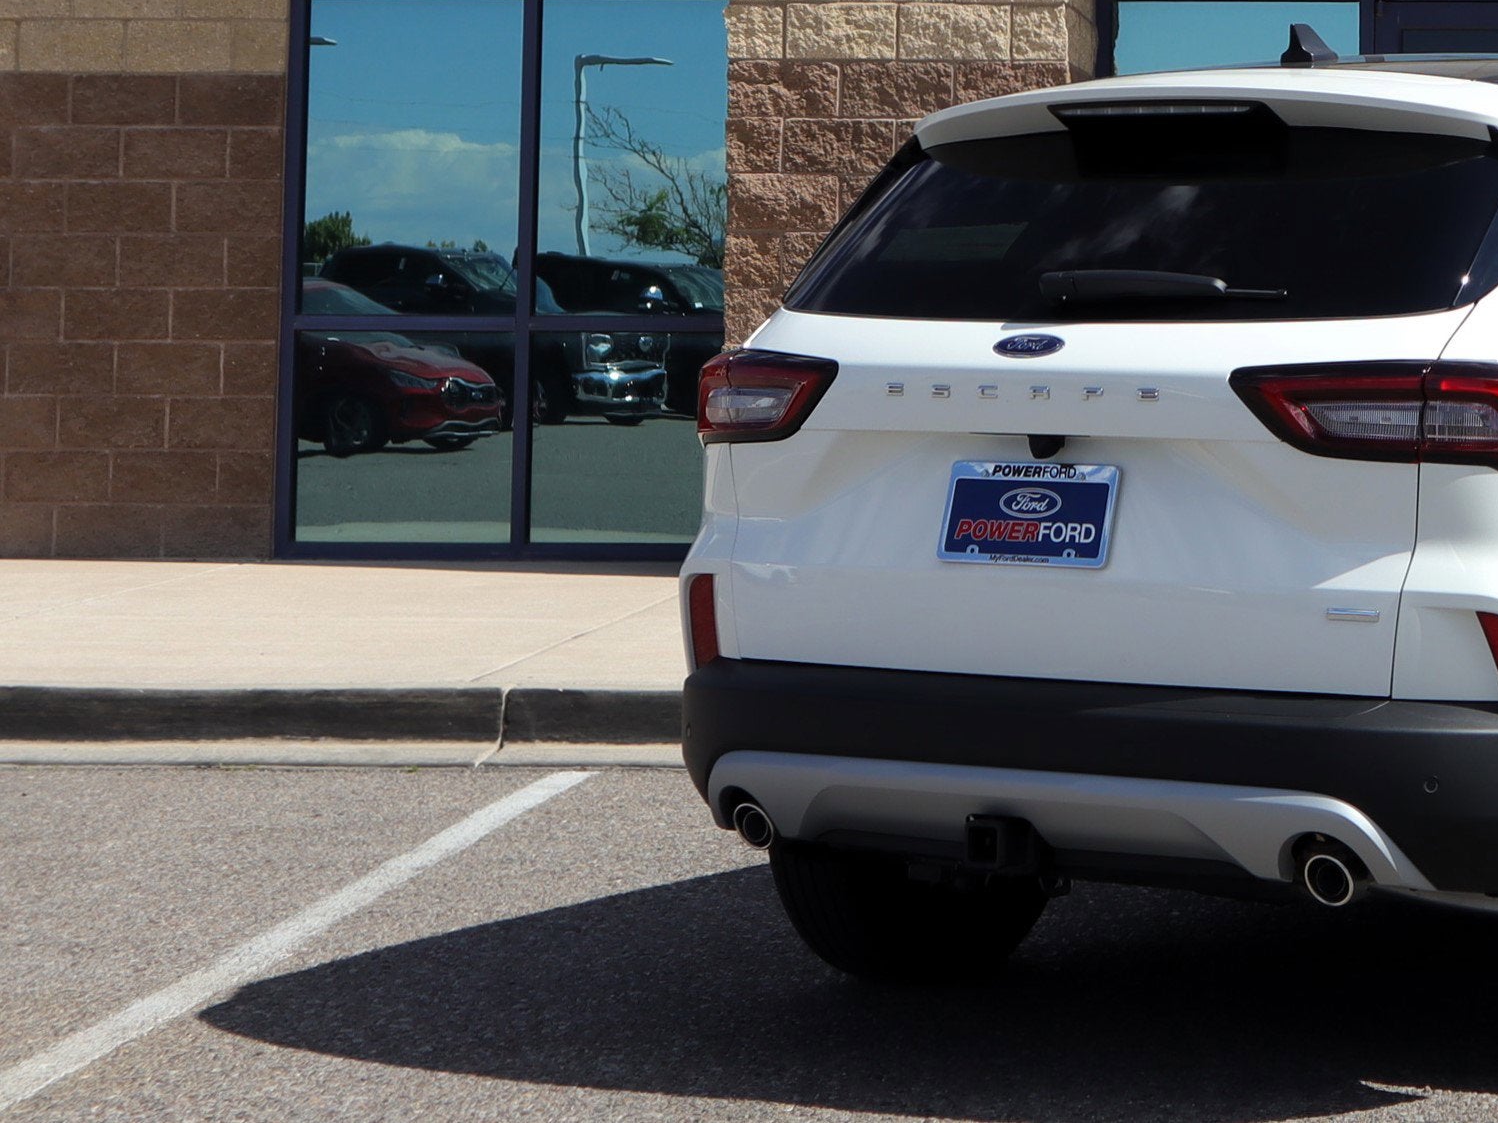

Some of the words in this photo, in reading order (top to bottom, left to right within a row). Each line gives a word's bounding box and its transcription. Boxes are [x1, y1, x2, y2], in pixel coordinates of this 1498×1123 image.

[1007, 336, 1047, 350] Ford
[885, 381, 1160, 402] ESCAPE
[992, 464, 1077, 479] POWERFORD
[1012, 492, 1048, 511] Ford
[954, 518, 1096, 544] POWERFORD
